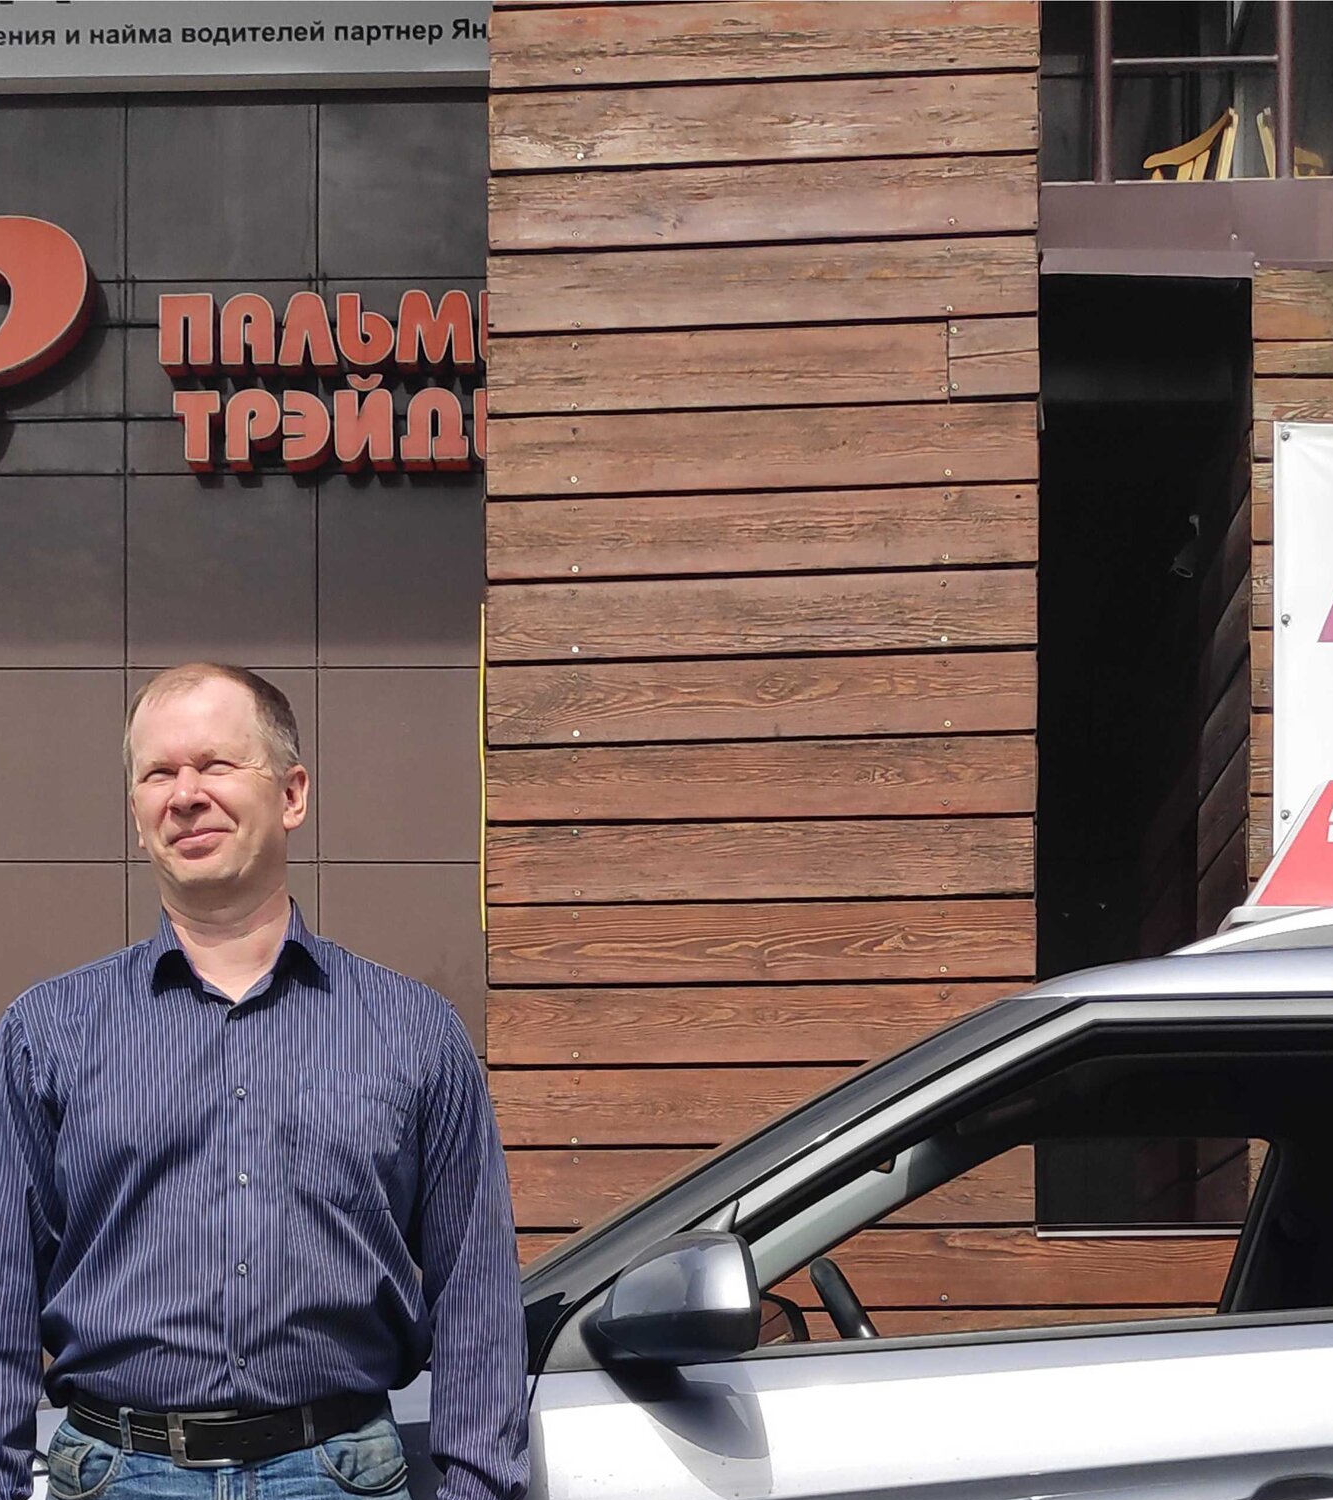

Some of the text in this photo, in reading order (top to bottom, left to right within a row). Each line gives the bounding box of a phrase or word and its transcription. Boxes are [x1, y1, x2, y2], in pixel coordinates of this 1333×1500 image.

[66, 29, 80, 44] и
[89, 24, 172, 45] найма
[181, 21, 325, 46] водителей
[334, 22, 443, 46] партнер
[159, 290, 487, 366] ПАЛЬМ
[173, 374, 487, 462] ТРЭЙД
